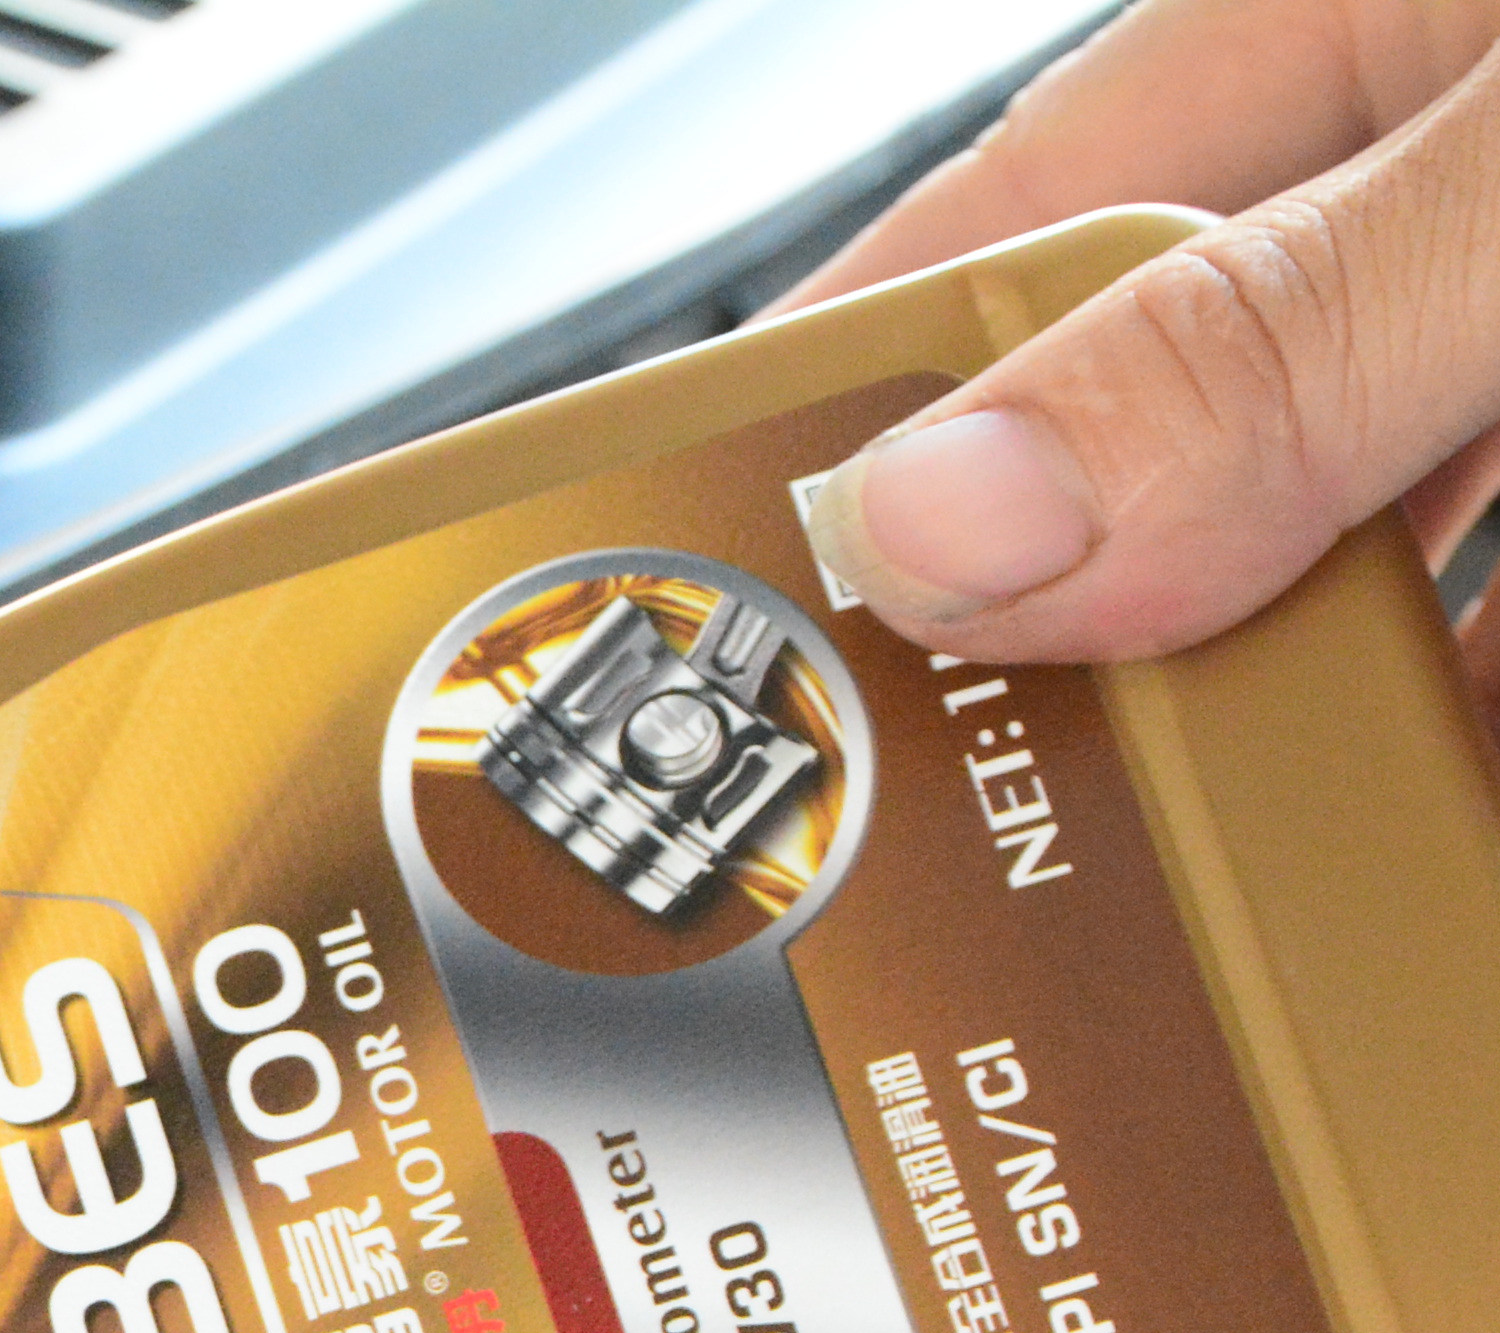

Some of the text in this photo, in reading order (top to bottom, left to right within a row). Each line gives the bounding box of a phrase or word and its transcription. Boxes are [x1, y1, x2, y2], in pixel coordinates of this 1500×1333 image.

[319, 909, 468, 1251] MOTOR OIL
[957, 1038, 1080, 1256] SN/CI
